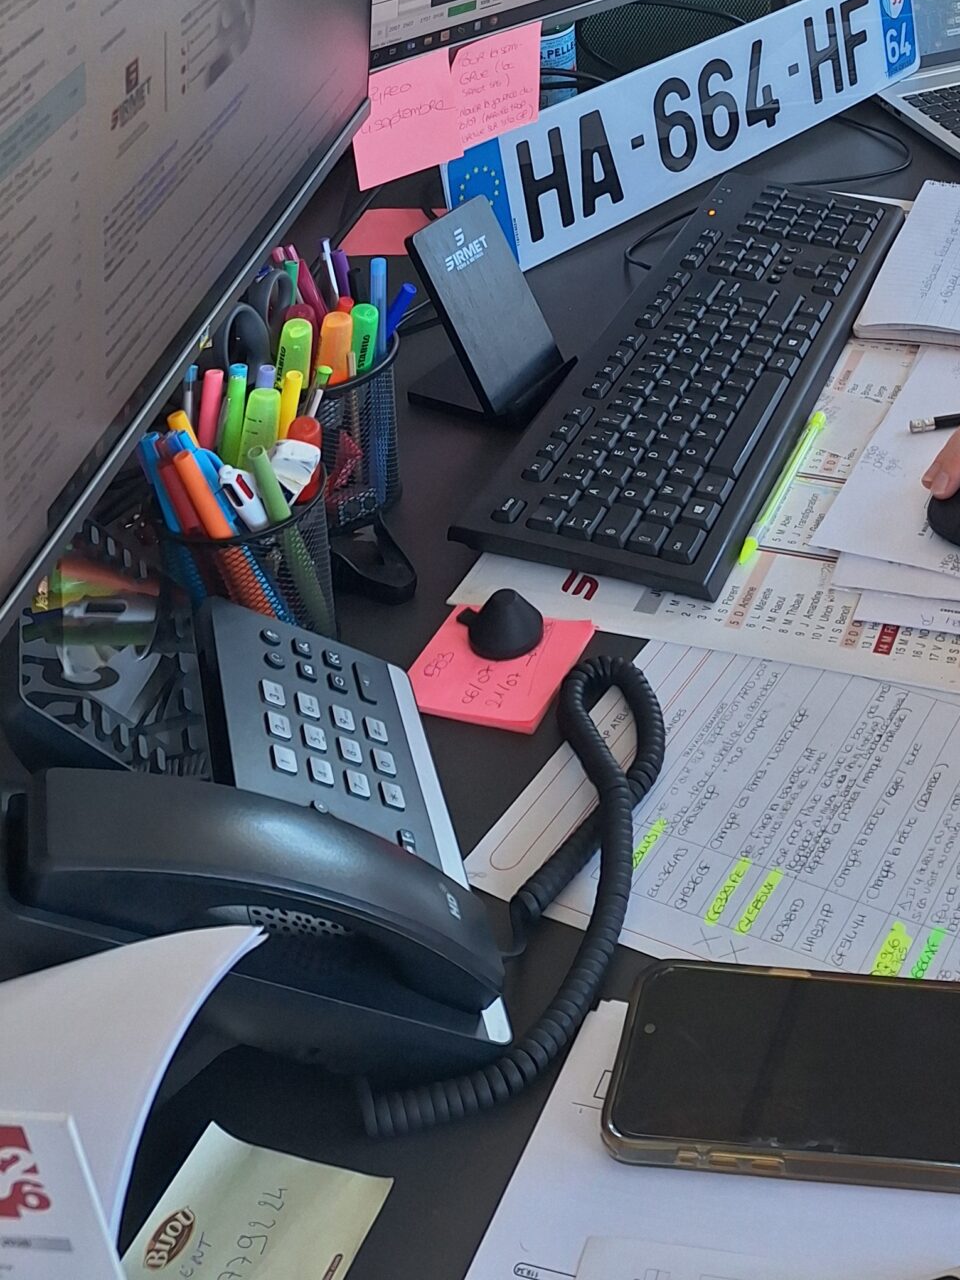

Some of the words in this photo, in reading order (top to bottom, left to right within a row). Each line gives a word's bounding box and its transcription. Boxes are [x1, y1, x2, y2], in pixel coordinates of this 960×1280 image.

[885, 22, 912, 64] 64
[445, 236, 487, 271] SIRMET
[721, 585, 740, 606] Florent
[738, 586, 757, 609] Antoine
[754, 588, 773, 611] Mariette
[769, 596, 786, 614] Raoul
[785, 593, 805, 616] Thibault
[803, 590, 824, 620] Amandine
[819, 604, 834, 622] Ulrich
[144, 1206, 195, 1270] BIJOU
